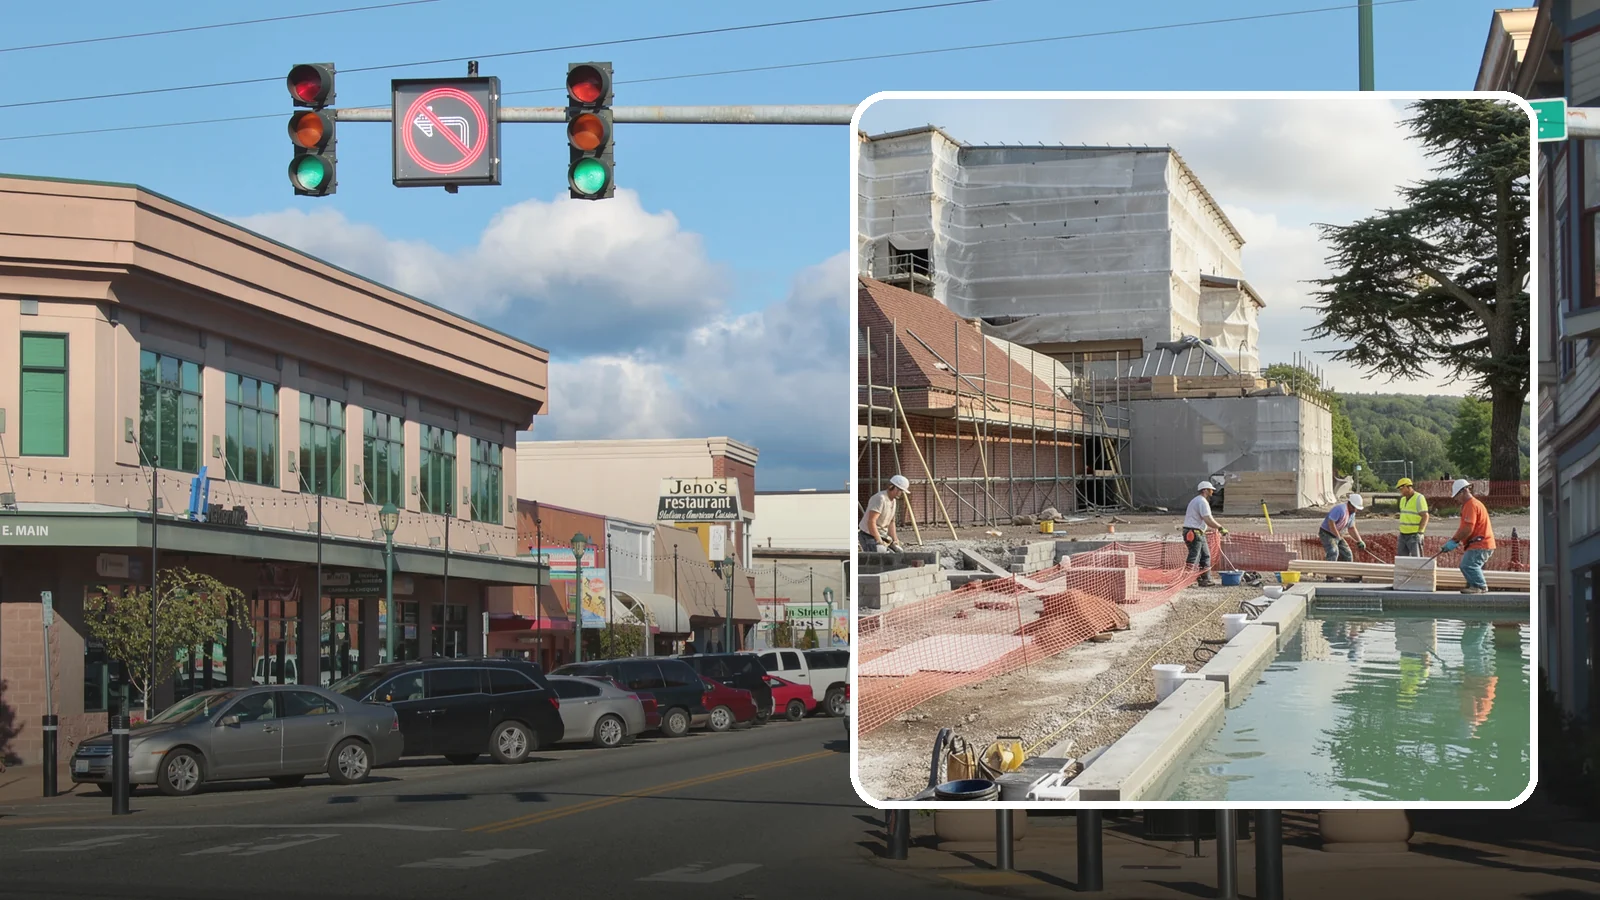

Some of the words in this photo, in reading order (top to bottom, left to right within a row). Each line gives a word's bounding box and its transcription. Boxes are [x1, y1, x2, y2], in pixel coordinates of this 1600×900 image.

[669, 480, 728, 495] Jeno's
[665, 496, 731, 509] restaurant
[658, 510, 681, 520] Italian
[686, 509, 715, 519] American
[715, 509, 738, 519] Cuisine
[2, 525, 13, 536] E.
[15, 525, 49, 536] MAIN
[786, 608, 795, 617] in
[797, 607, 828, 616] Street
[791, 619, 824, 627] lass
